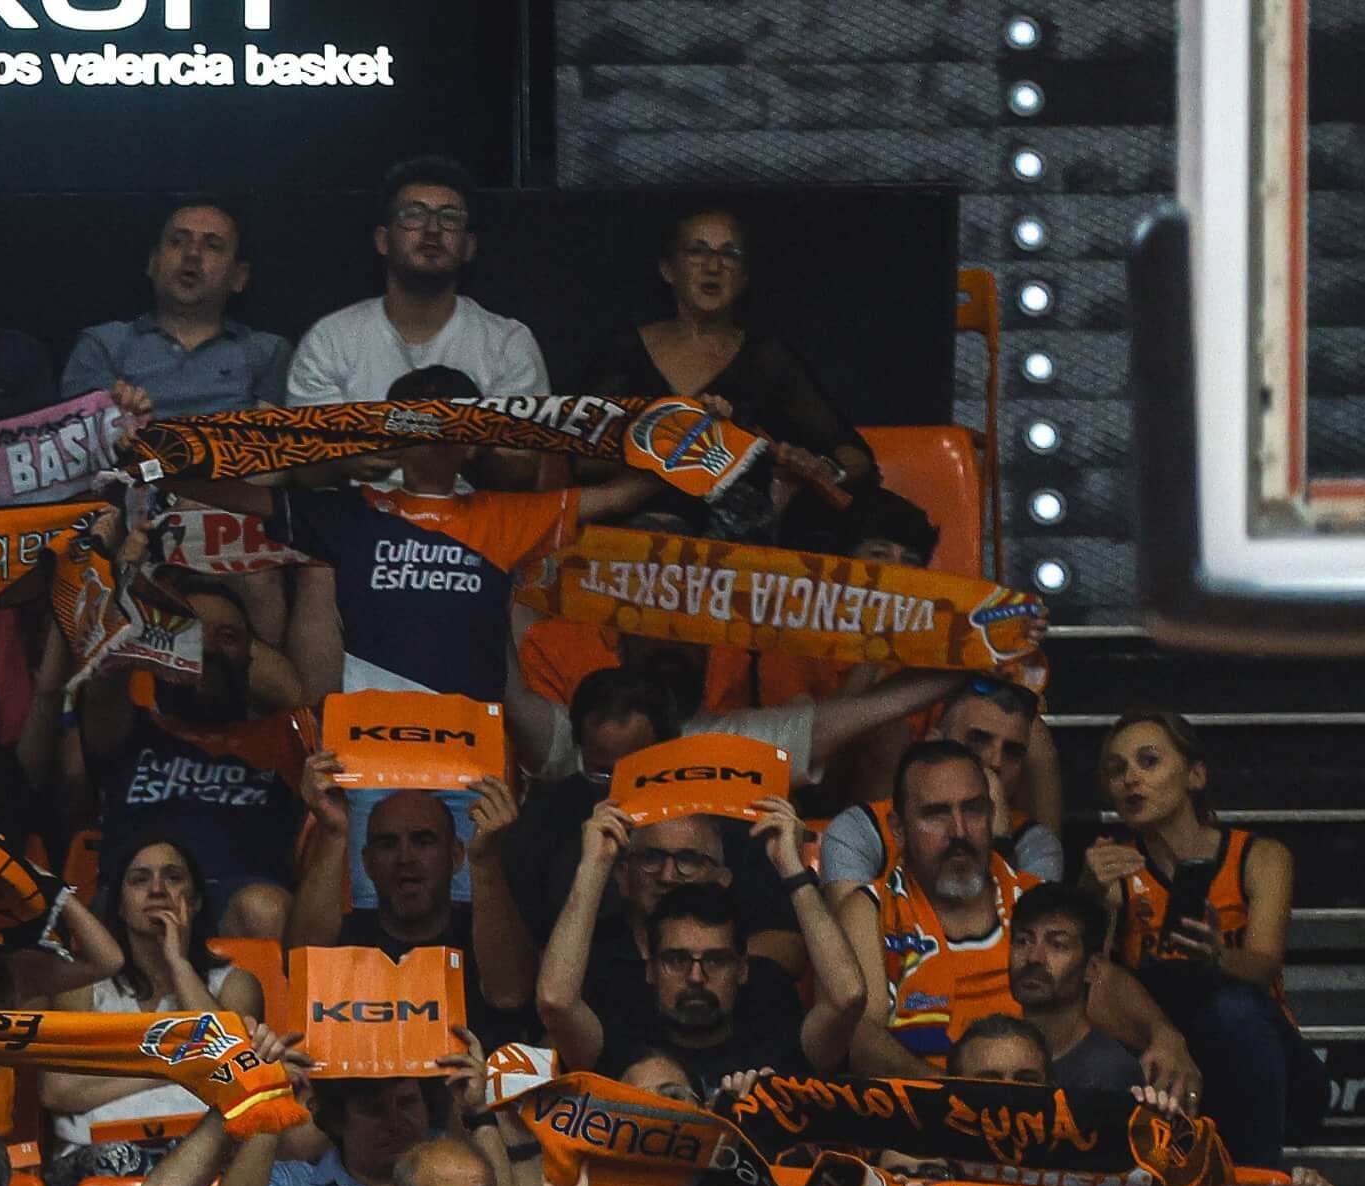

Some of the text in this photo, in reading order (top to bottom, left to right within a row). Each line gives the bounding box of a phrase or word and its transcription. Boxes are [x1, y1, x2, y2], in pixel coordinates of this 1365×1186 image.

[50, 44, 235, 88] valencia
[244, 44, 396, 88] basket
[374, 538, 464, 566] Cultura
[370, 562, 483, 593] Esfuerzo
[578, 560, 937, 633] VALENCIA BASKET
[349, 726, 477, 748] KGM
[633, 764, 761, 787] KGM
[312, 1000, 439, 1023] KGM
[533, 1092, 701, 1159] valencia
